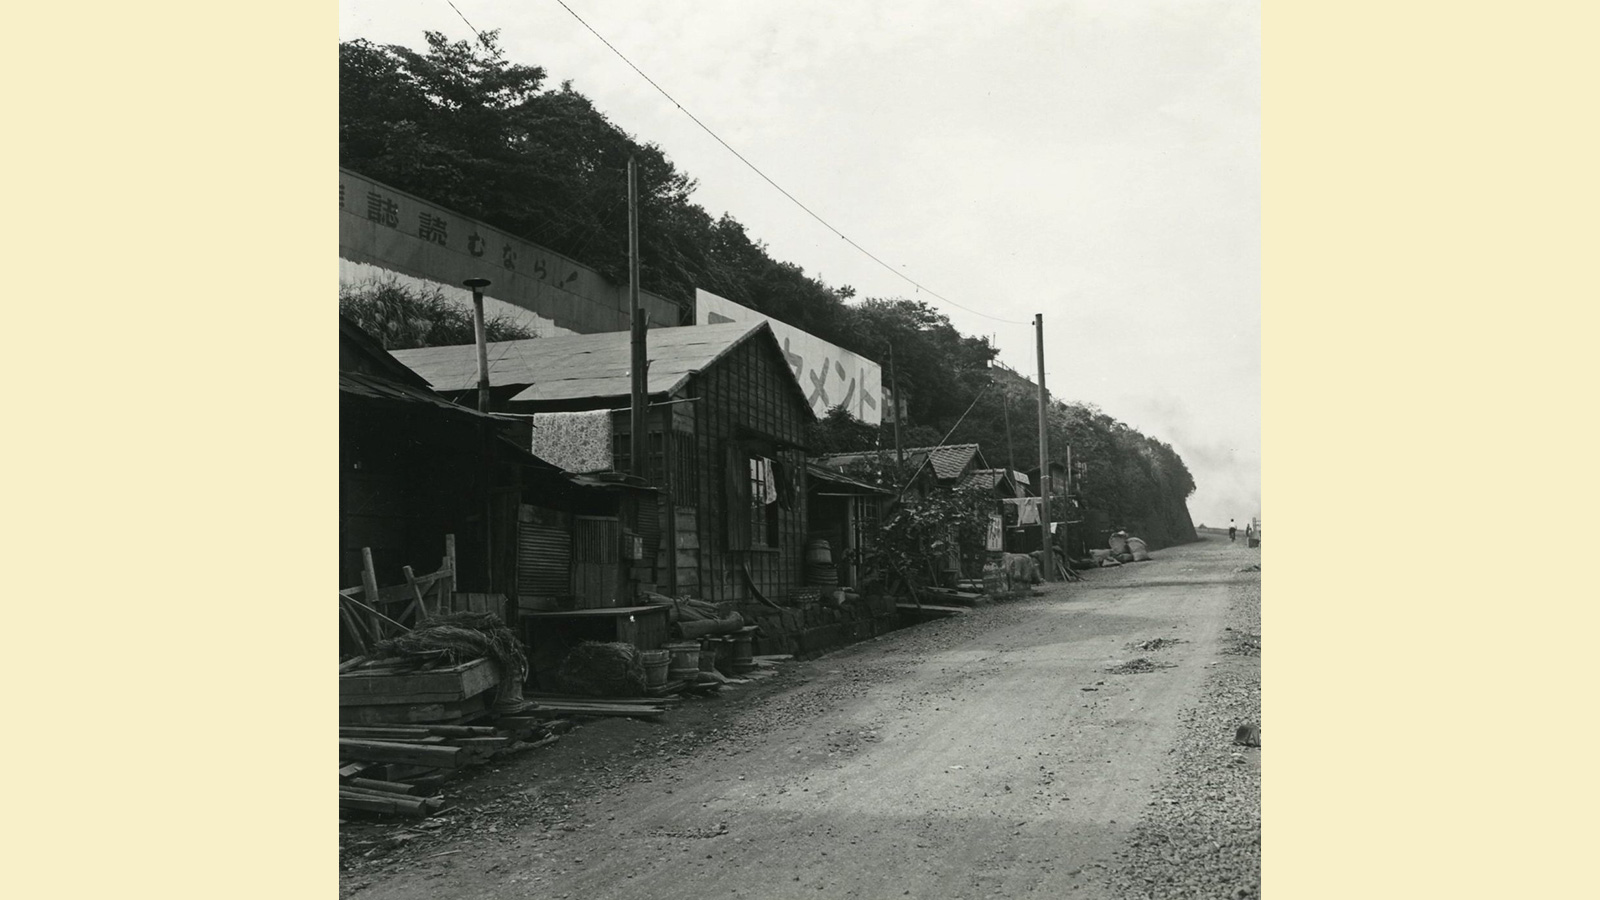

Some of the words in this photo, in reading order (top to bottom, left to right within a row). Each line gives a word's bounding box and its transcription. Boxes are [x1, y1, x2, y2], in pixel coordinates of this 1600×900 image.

[339, 184, 578, 288] 誌読むなら!
